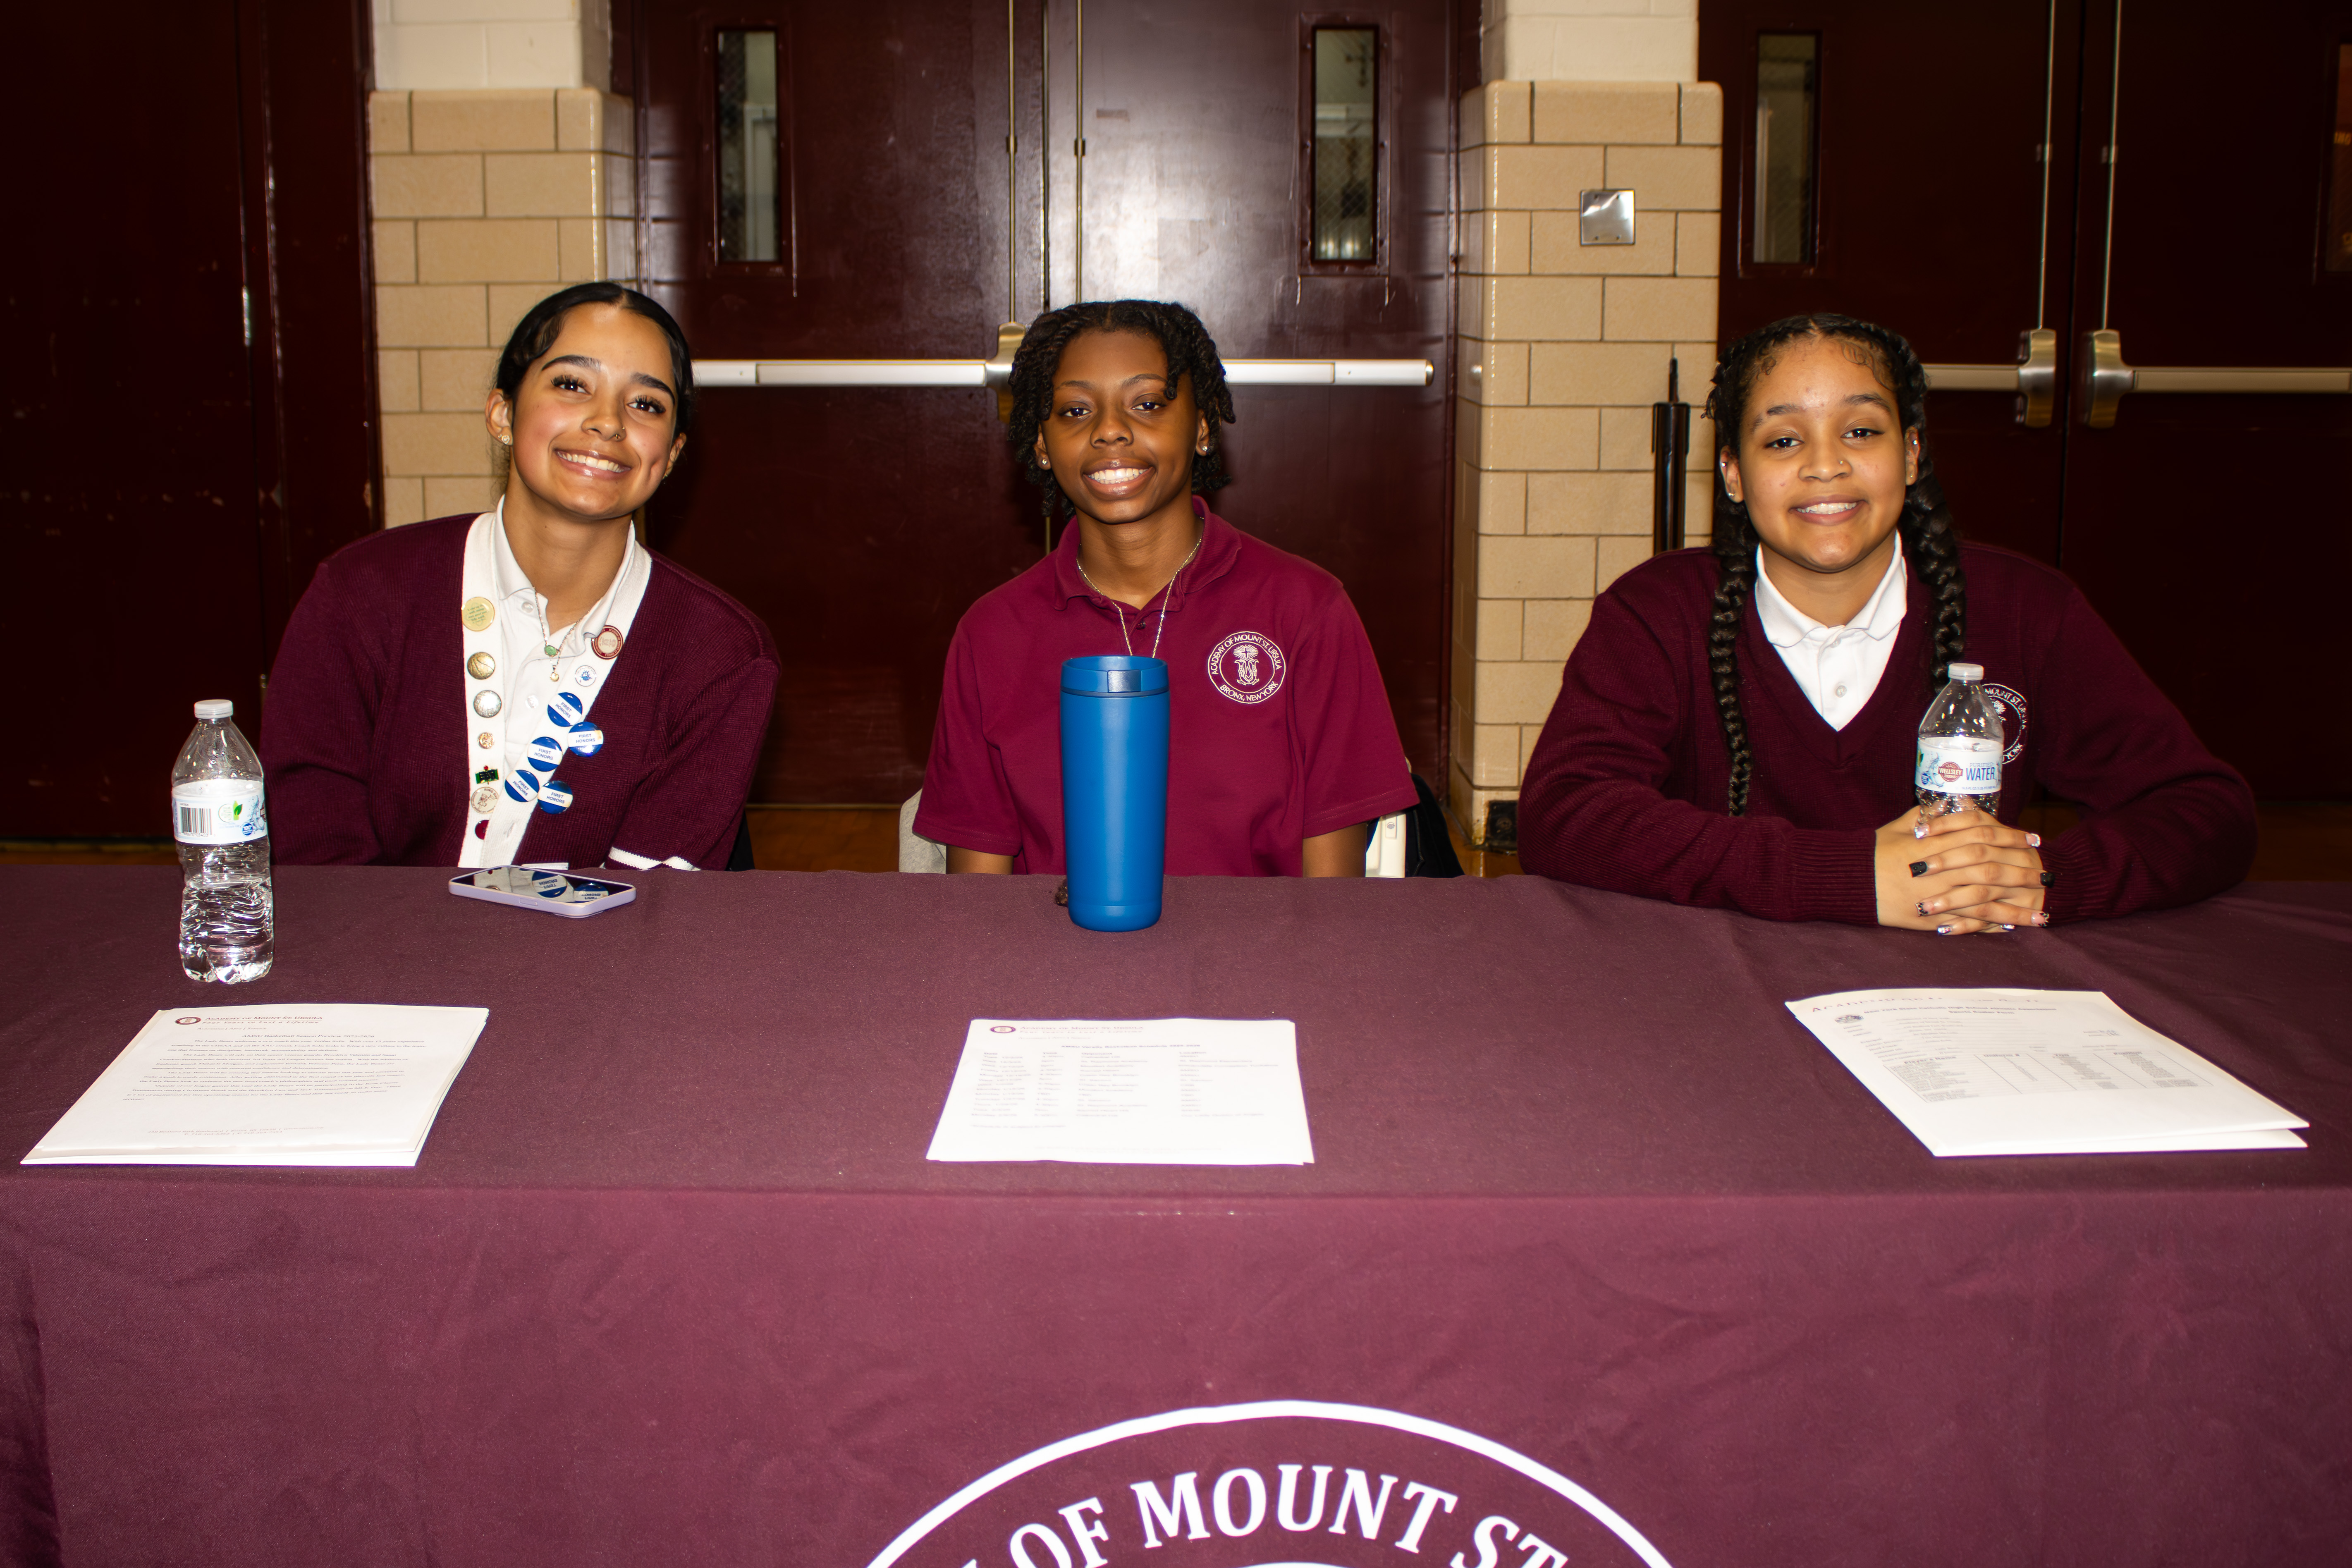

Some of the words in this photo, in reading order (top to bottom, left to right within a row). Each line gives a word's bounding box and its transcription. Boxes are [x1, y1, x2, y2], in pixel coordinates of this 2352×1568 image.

[1211, 645, 1226, 674] ACADEMY
[1224, 638, 1234, 648] OF
[1233, 634, 1263, 644] MOUNT
[1261, 640, 1270, 649] ST.
[1268, 646, 1282, 670] URSULA
[1220, 684, 1245, 702] BRONX,
[1260, 681, 1279, 697] YORK
[1985, 687, 2013, 700] MOUNT
[2010, 696, 2022, 705] ST.
[555, 703, 571, 718] HONORS
[561, 702, 572, 712] FIRST
[1965, 767, 1995, 781] WATER
[512, 781, 528, 796] HONORS
[518, 780, 530, 791] FIRST
[546, 796, 565, 804] HONORS
[1010, 1496, 1109, 1568] OF
[1130, 1464, 1458, 1554] MOUNT
